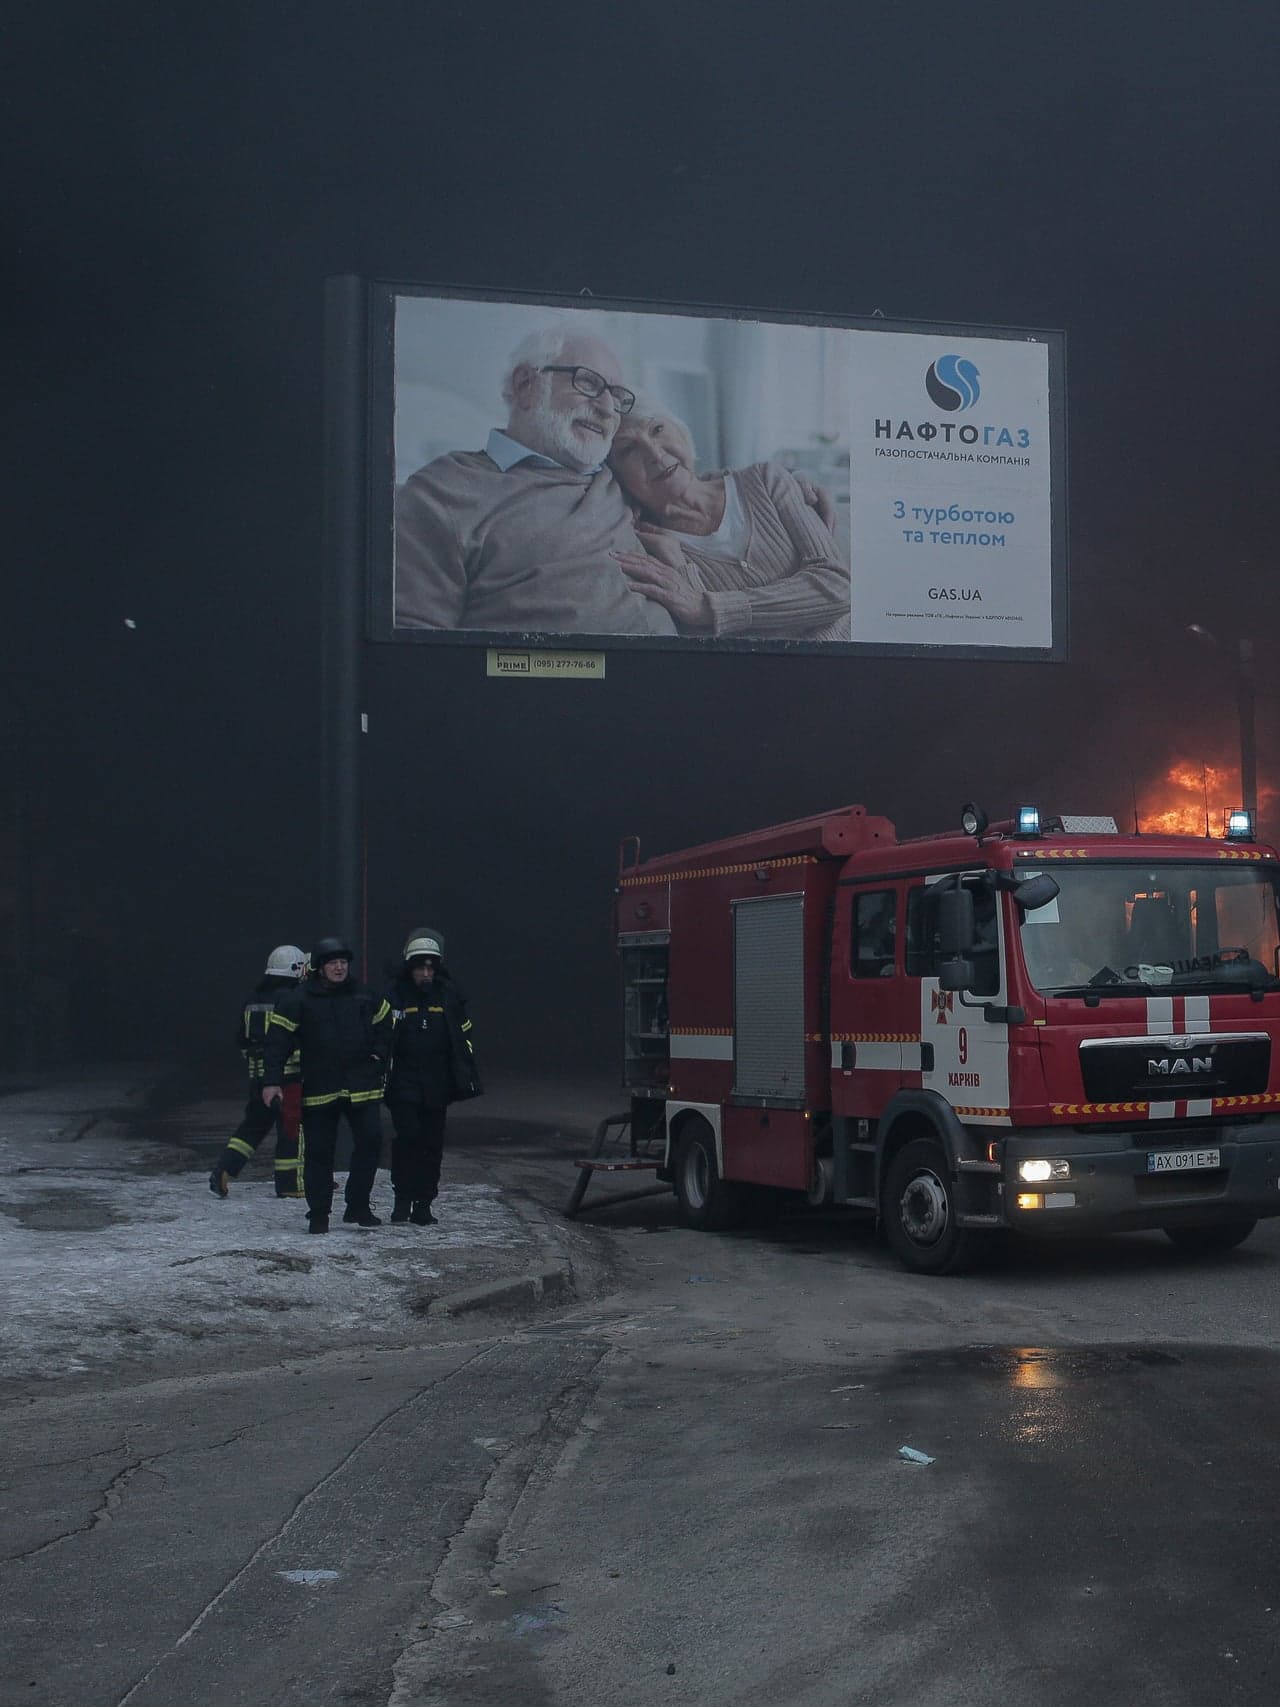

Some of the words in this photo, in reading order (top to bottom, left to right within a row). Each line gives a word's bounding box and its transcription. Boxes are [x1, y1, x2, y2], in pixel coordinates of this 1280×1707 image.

[875, 419, 1030, 448] НАФТОГАЗ
[874, 447, 975, 463] ГАЗОПОСТАЧАЛЬНА
[976, 454, 1031, 467] КОМПАНІЯ
[893, 501, 906, 519] З
[912, 504, 1015, 525] турботою
[902, 528, 924, 543] та
[930, 530, 1006, 547] теплом
[928, 588, 982, 602] GAS.UA
[497, 662, 527, 670] PRIME
[533, 659, 555, 669] (095)
[959, 1027, 968, 1065] 9
[1147, 1057, 1214, 1075] MAN
[948, 1072, 980, 1087] ХАРКІВ
